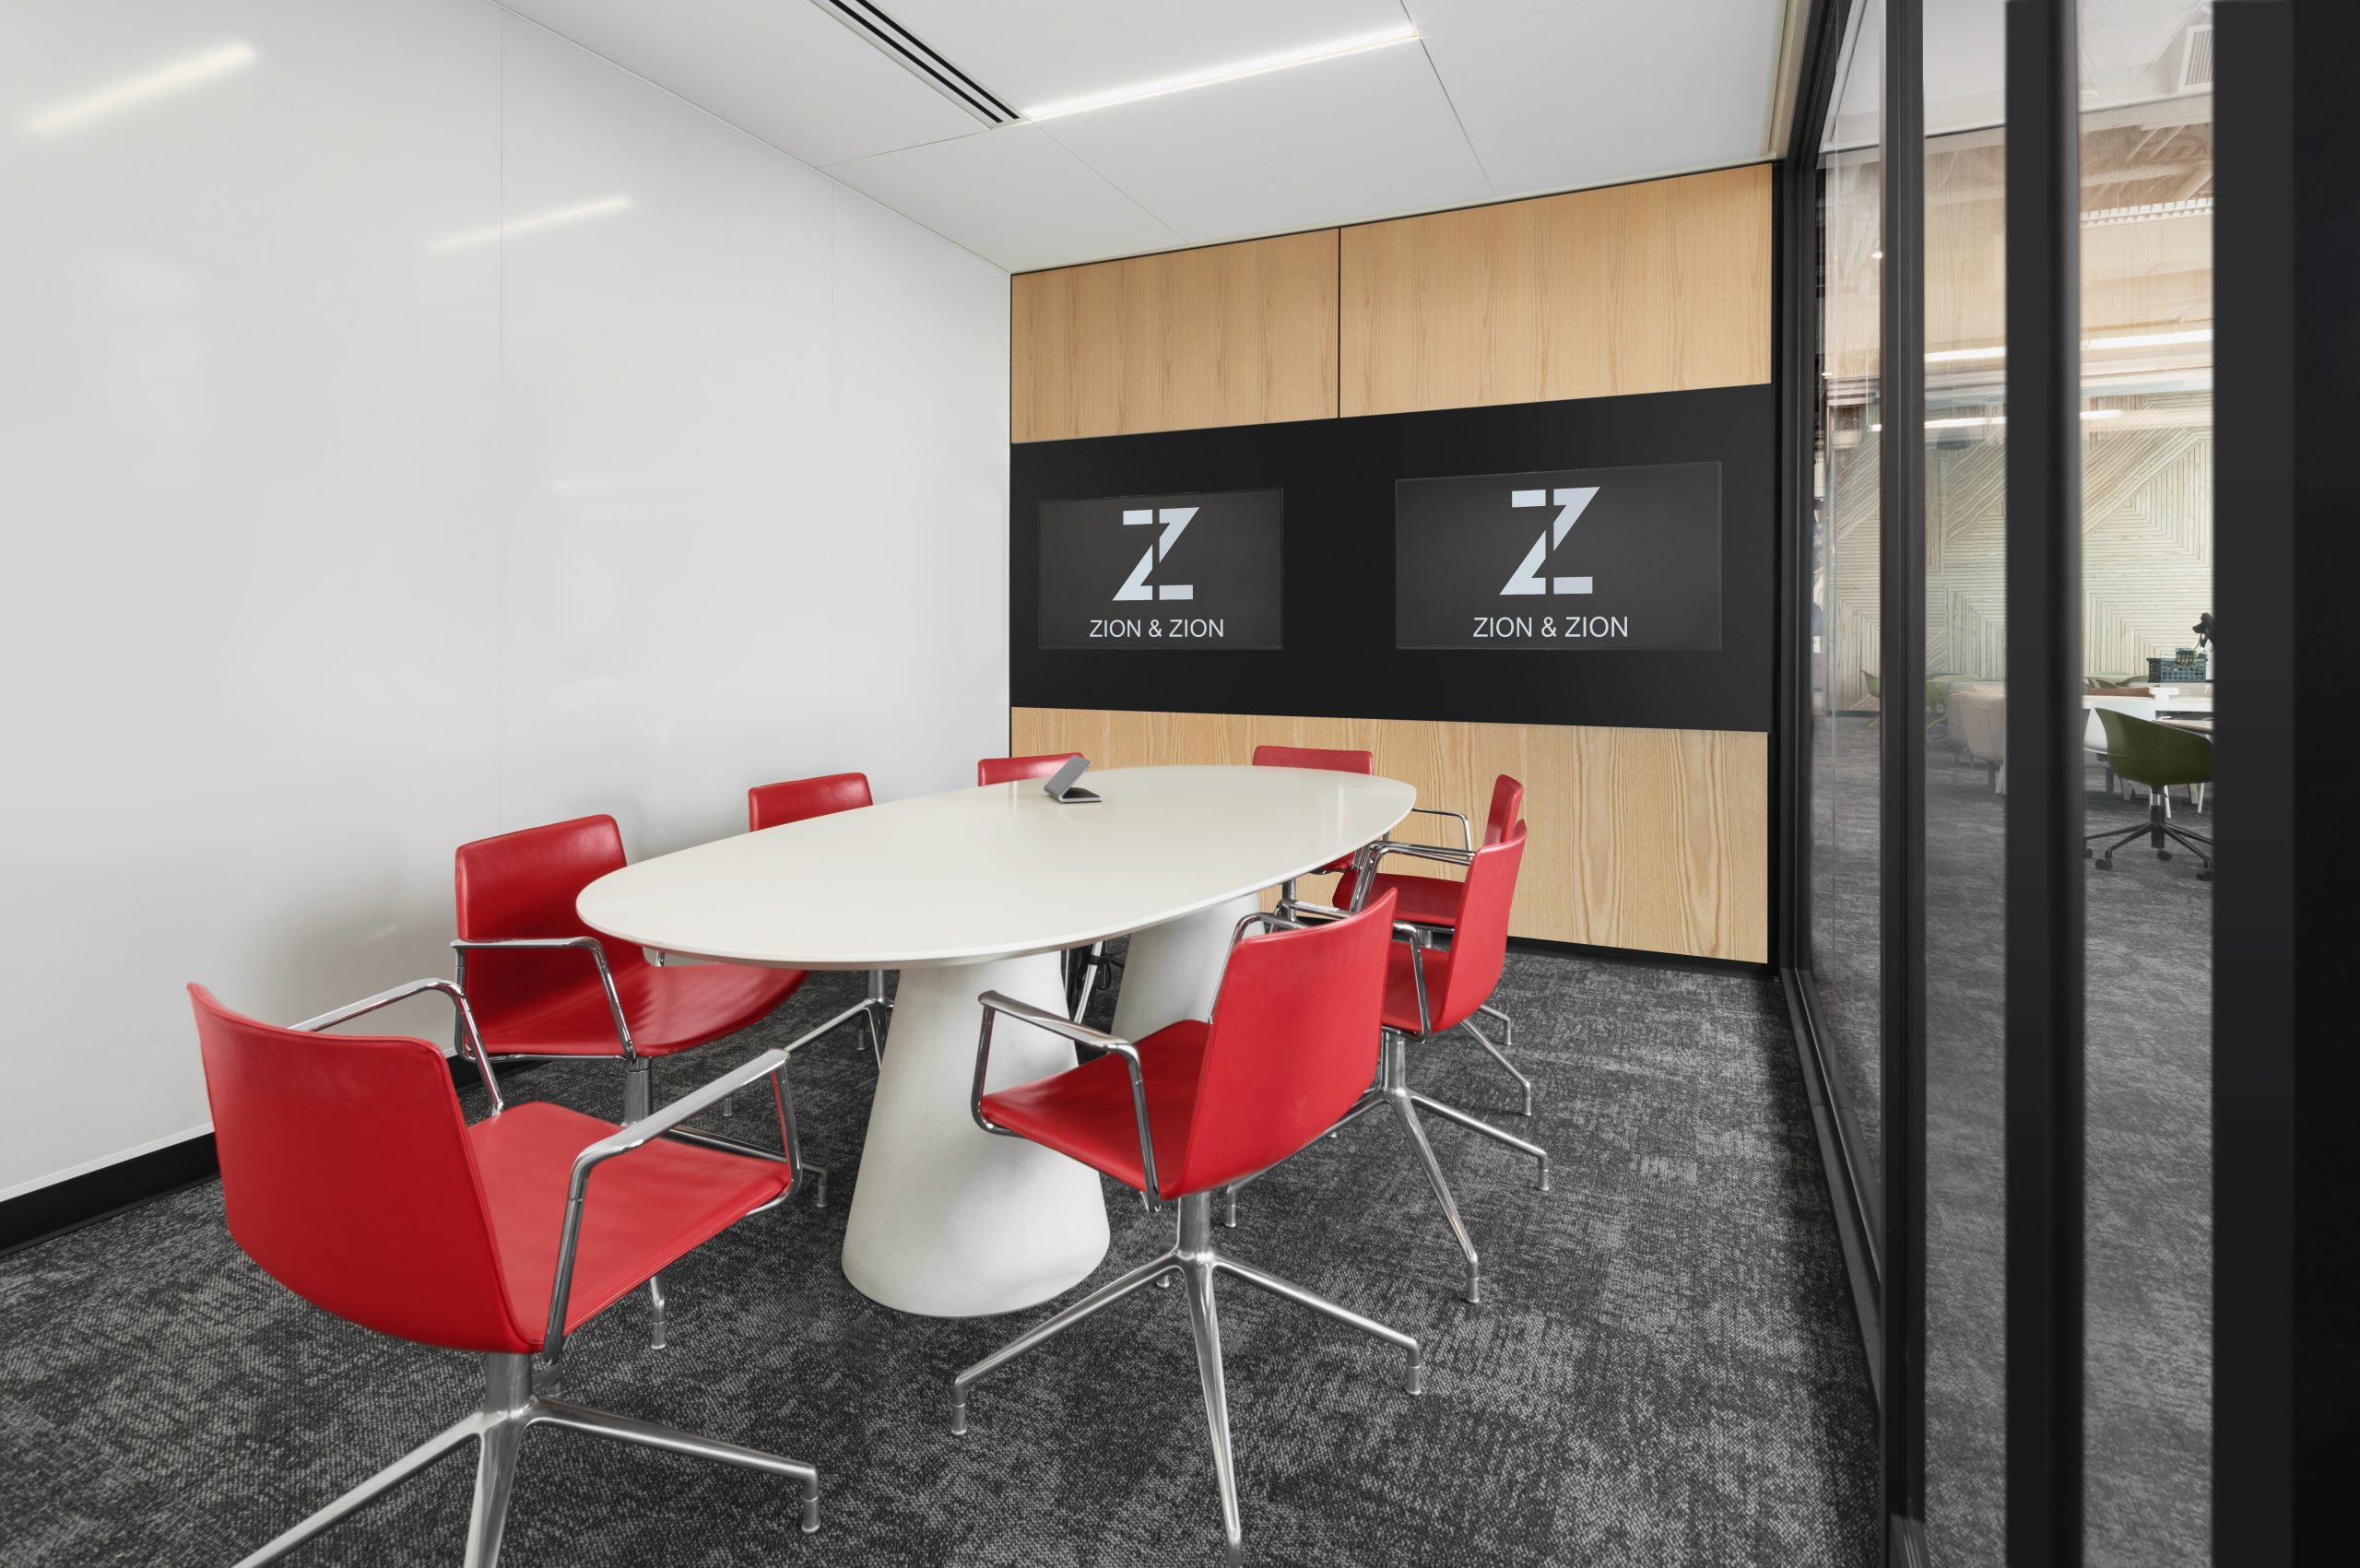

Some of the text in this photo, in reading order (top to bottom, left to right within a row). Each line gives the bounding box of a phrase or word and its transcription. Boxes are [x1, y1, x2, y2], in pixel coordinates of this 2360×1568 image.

[1089, 619, 1224, 638] ZION & ZION
[1472, 616, 1628, 638] ZION & ZION
